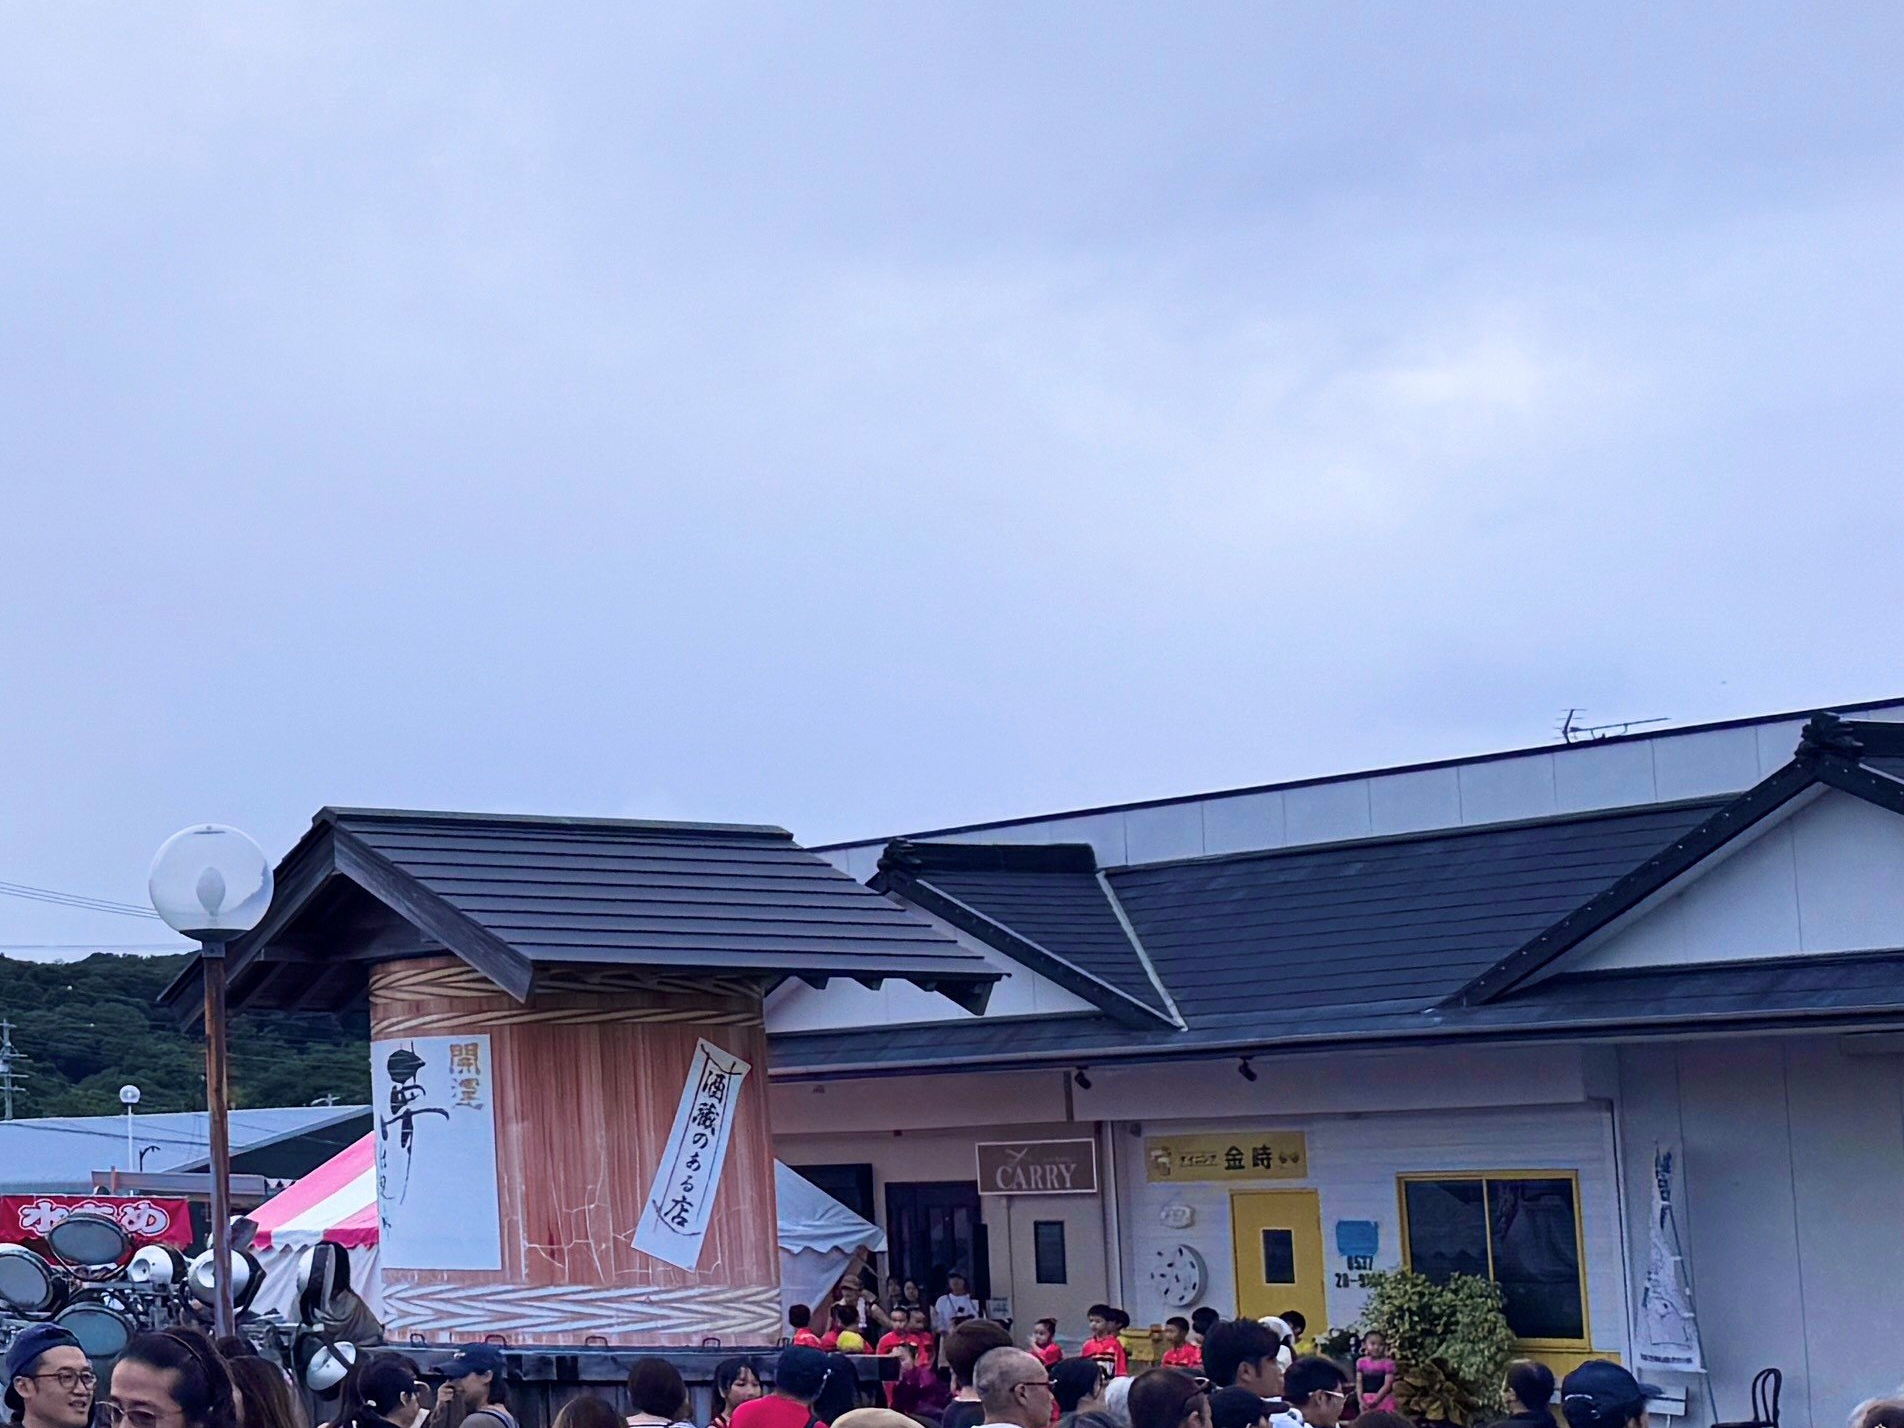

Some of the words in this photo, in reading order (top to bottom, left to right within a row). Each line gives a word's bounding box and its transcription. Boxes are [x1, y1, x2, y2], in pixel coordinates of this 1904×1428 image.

[663, 1071, 726, 1228] 酒蔵のある店
[1224, 1145, 1272, 1171] 金時
[996, 1163, 1078, 1190] CARRY
